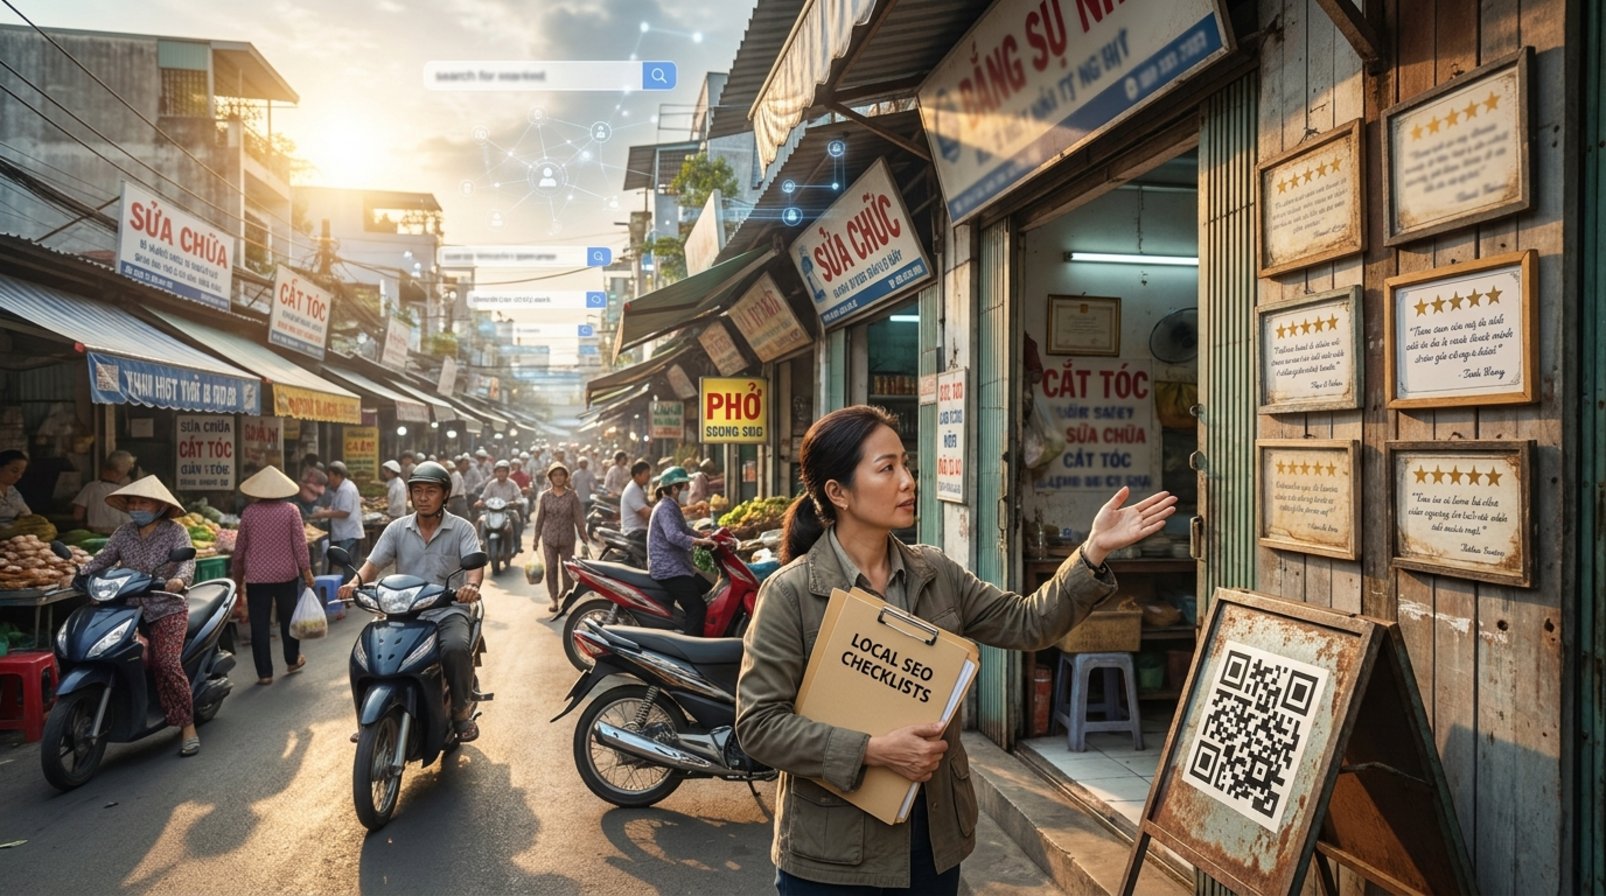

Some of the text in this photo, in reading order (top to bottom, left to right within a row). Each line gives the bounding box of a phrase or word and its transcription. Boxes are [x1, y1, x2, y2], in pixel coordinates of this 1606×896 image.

[130, 200, 174, 246] SỬA
[814, 226, 855, 283] SỬA
[306, 293, 327, 322] TÓC
[1042, 359, 1149, 400] CẮT TÓC
[706, 381, 763, 421] PHỞ
[207, 437, 232, 459] TÓC
[1100, 448, 1132, 469] TÓC
[841, 651, 932, 703] CHECKLISTS
[851, 633, 933, 682] LOCAL SEO
